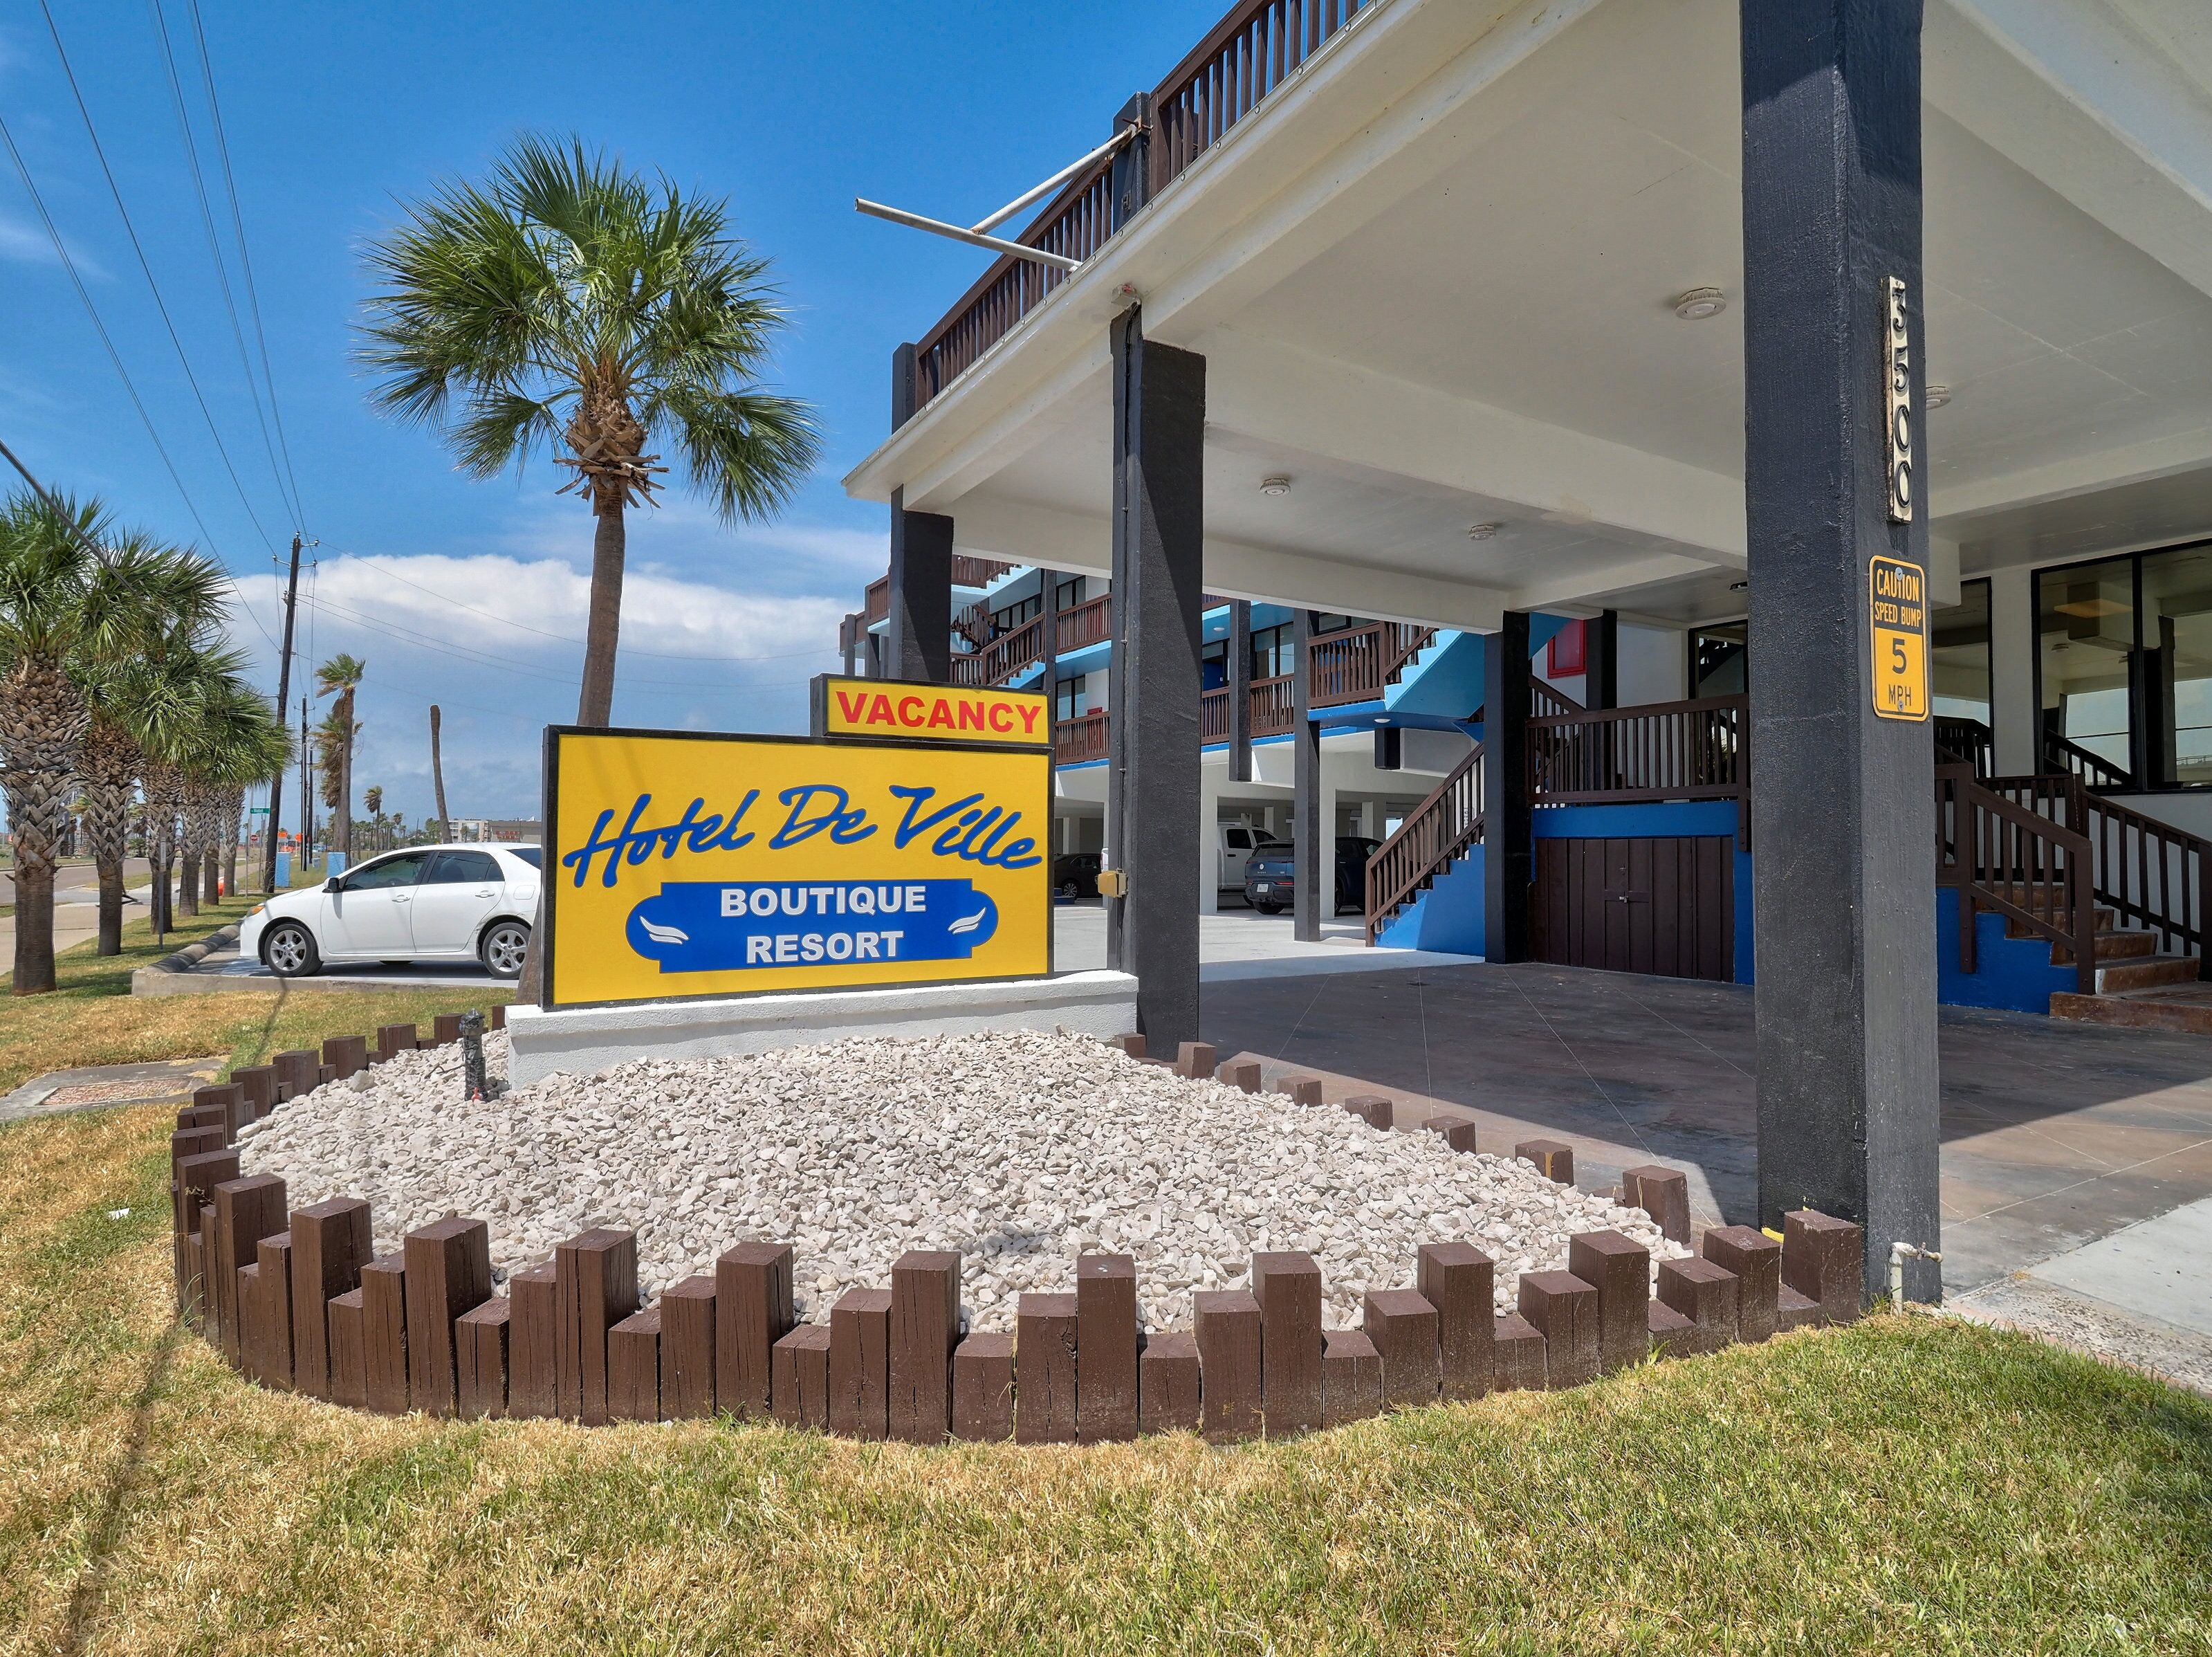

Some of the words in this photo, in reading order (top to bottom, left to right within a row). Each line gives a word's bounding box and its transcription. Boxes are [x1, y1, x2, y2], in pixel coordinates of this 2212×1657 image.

[1892, 286, 1912, 507] 3500
[1877, 569, 1919, 602] CAUTION
[1874, 601, 1897, 623] SPEED
[1901, 606, 1921, 628] BUMP
[1892, 637, 1907, 675] 5
[1888, 684, 1912, 706] MPH
[836, 691, 1042, 734] VACANCY
[562, 789, 760, 888] Hotel
[768, 784, 878, 850] De
[889, 785, 1043, 870] Ville
[719, 886, 928, 917] BOUTIQUE
[746, 930, 904, 964] RESORT
